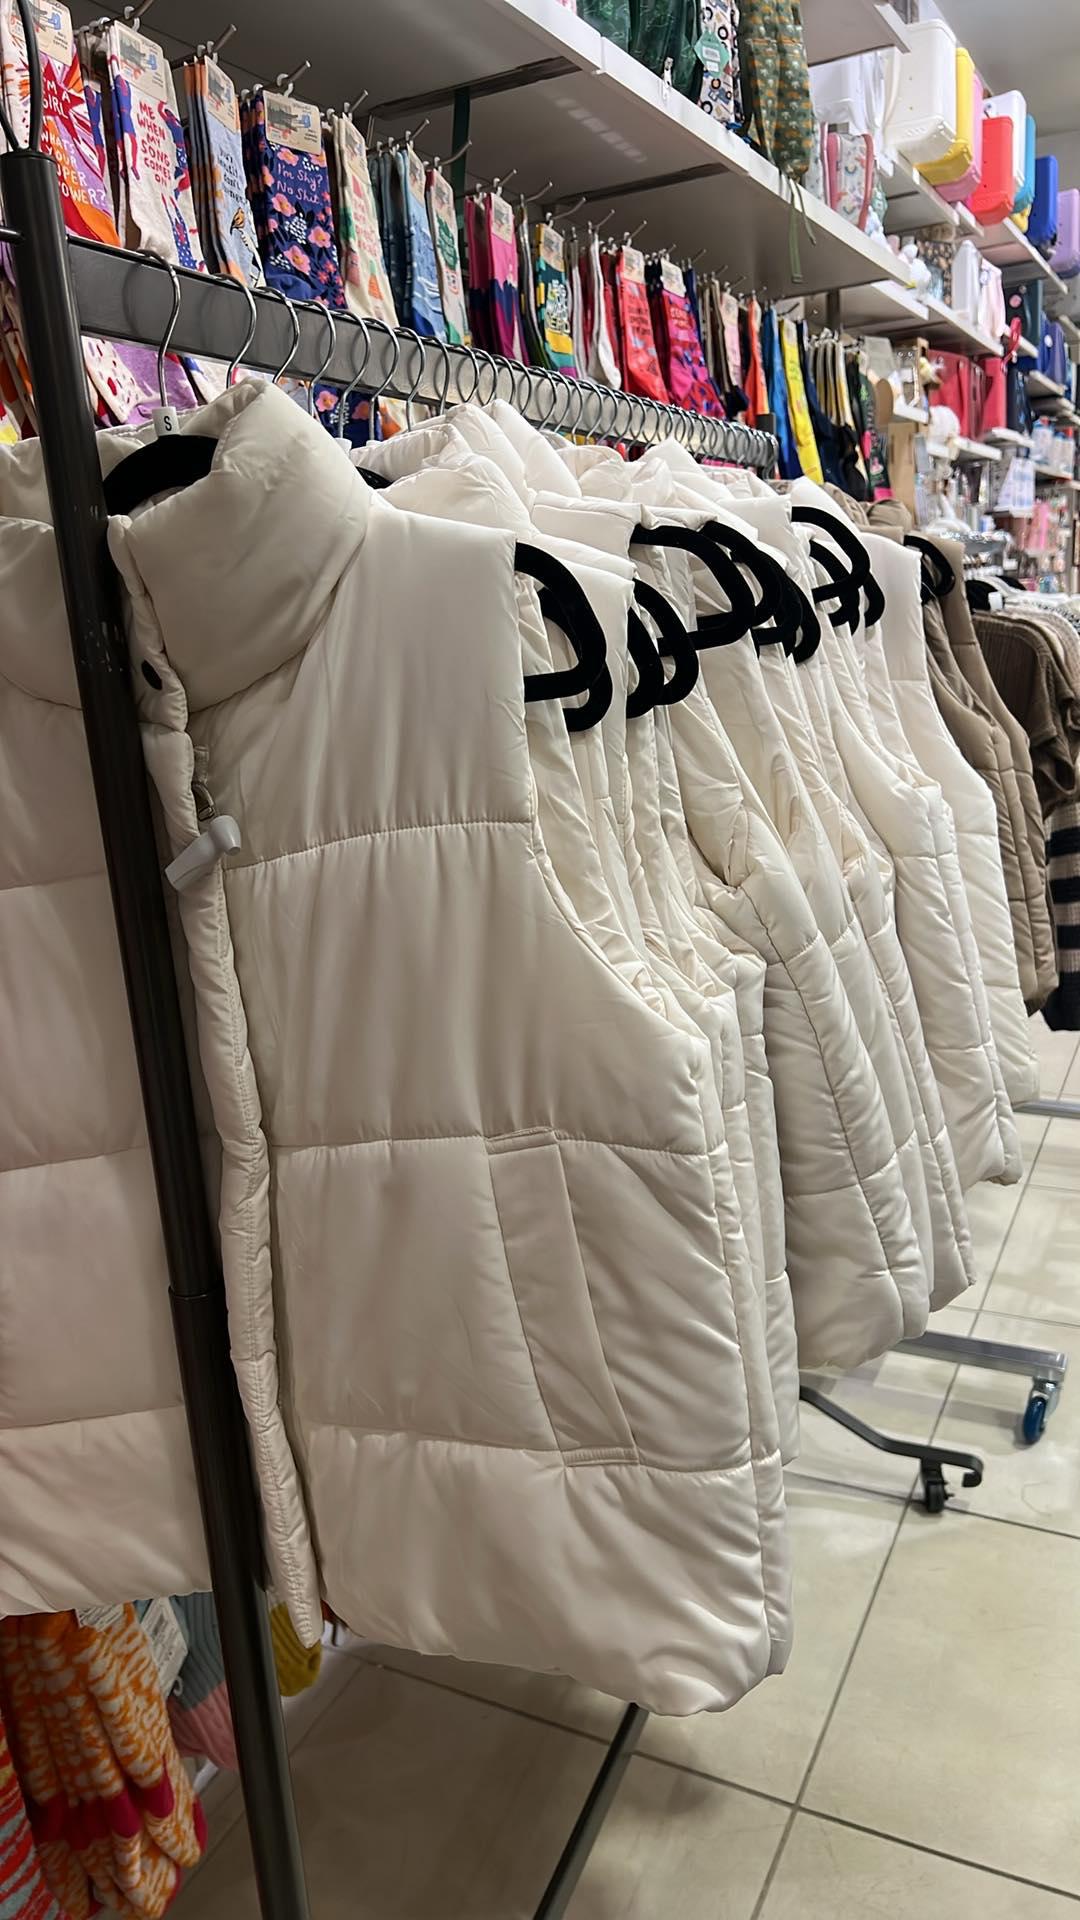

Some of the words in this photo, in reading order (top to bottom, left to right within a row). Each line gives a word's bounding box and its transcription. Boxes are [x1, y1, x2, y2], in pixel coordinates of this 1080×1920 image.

[62, 91, 71, 103] A
[140, 101, 156, 120] ME
[137, 113, 166, 141] WHEN
[141, 139, 171, 168] SONG
[144, 157, 171, 181] COMES
[278, 163, 295, 180] I'm
[297, 169, 323, 192] Shy?
[155, 174, 167, 186] ON
[277, 180, 294, 196] No
[58, 184, 106, 205] OWER?
[163, 415, 173, 432] S
